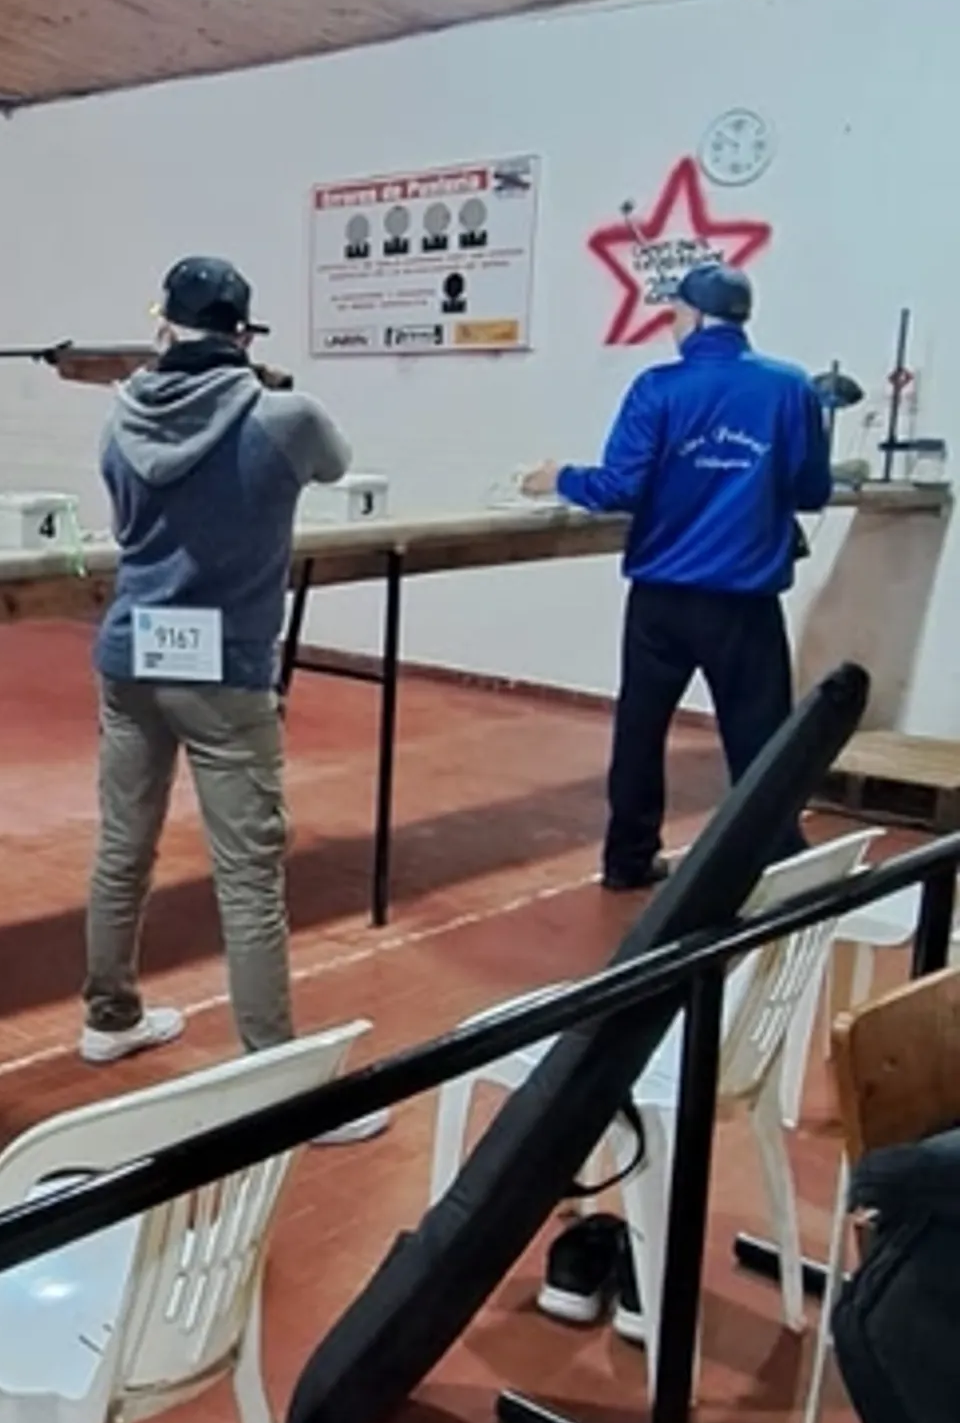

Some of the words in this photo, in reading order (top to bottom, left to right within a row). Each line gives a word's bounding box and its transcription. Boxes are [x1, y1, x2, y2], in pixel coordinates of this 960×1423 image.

[360, 490, 375, 516] 3
[38, 510, 58, 539] 4
[154, 625, 202, 650] 9167
